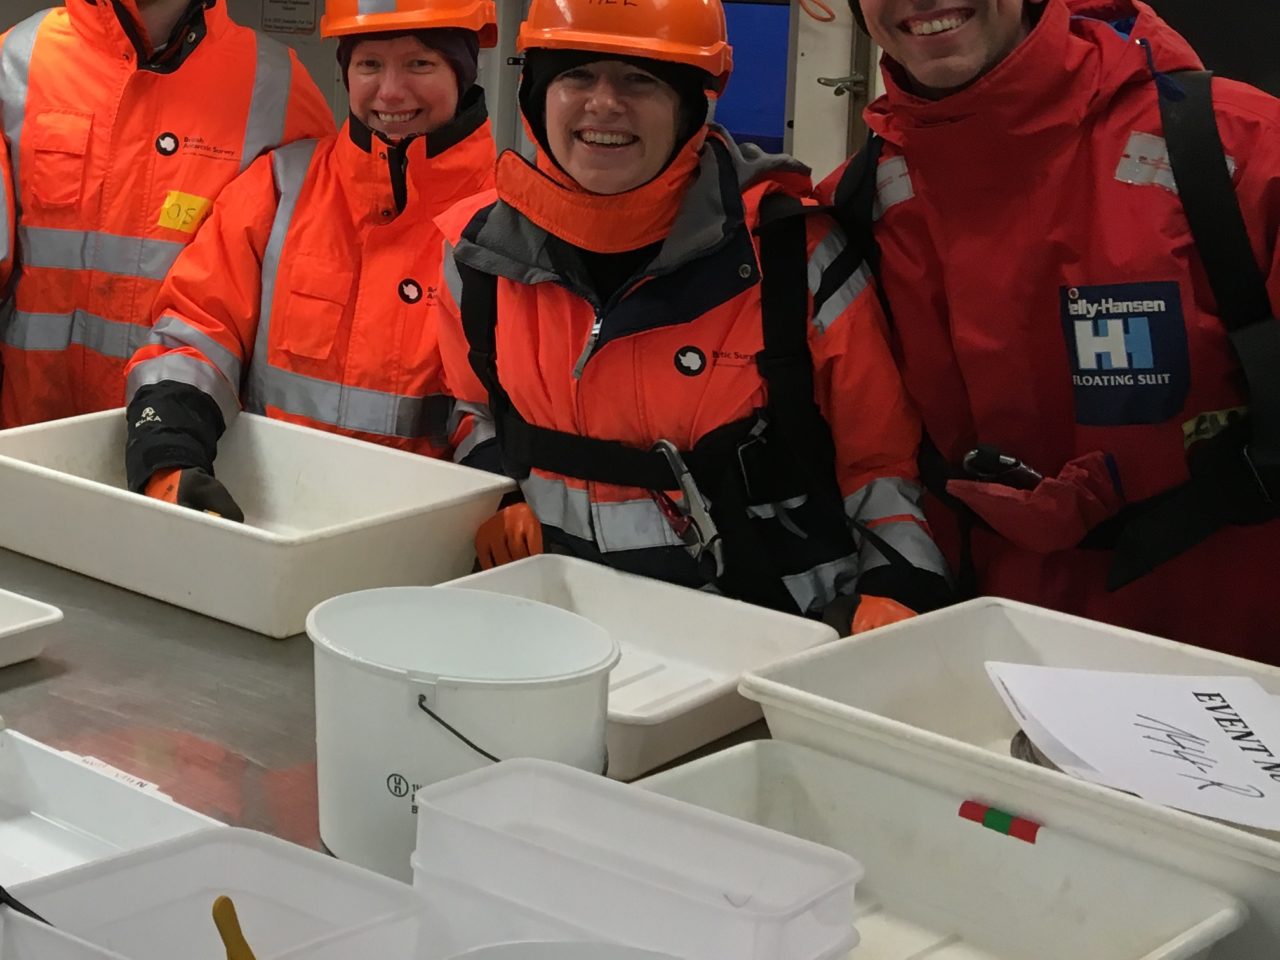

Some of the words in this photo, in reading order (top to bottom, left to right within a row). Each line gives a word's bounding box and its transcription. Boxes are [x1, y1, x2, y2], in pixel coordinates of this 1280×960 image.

[1068, 297, 1166, 318] elly-Hansen
[1137, 373, 1171, 385] SUIT
[1191, 690, 1275, 758] EVENT
